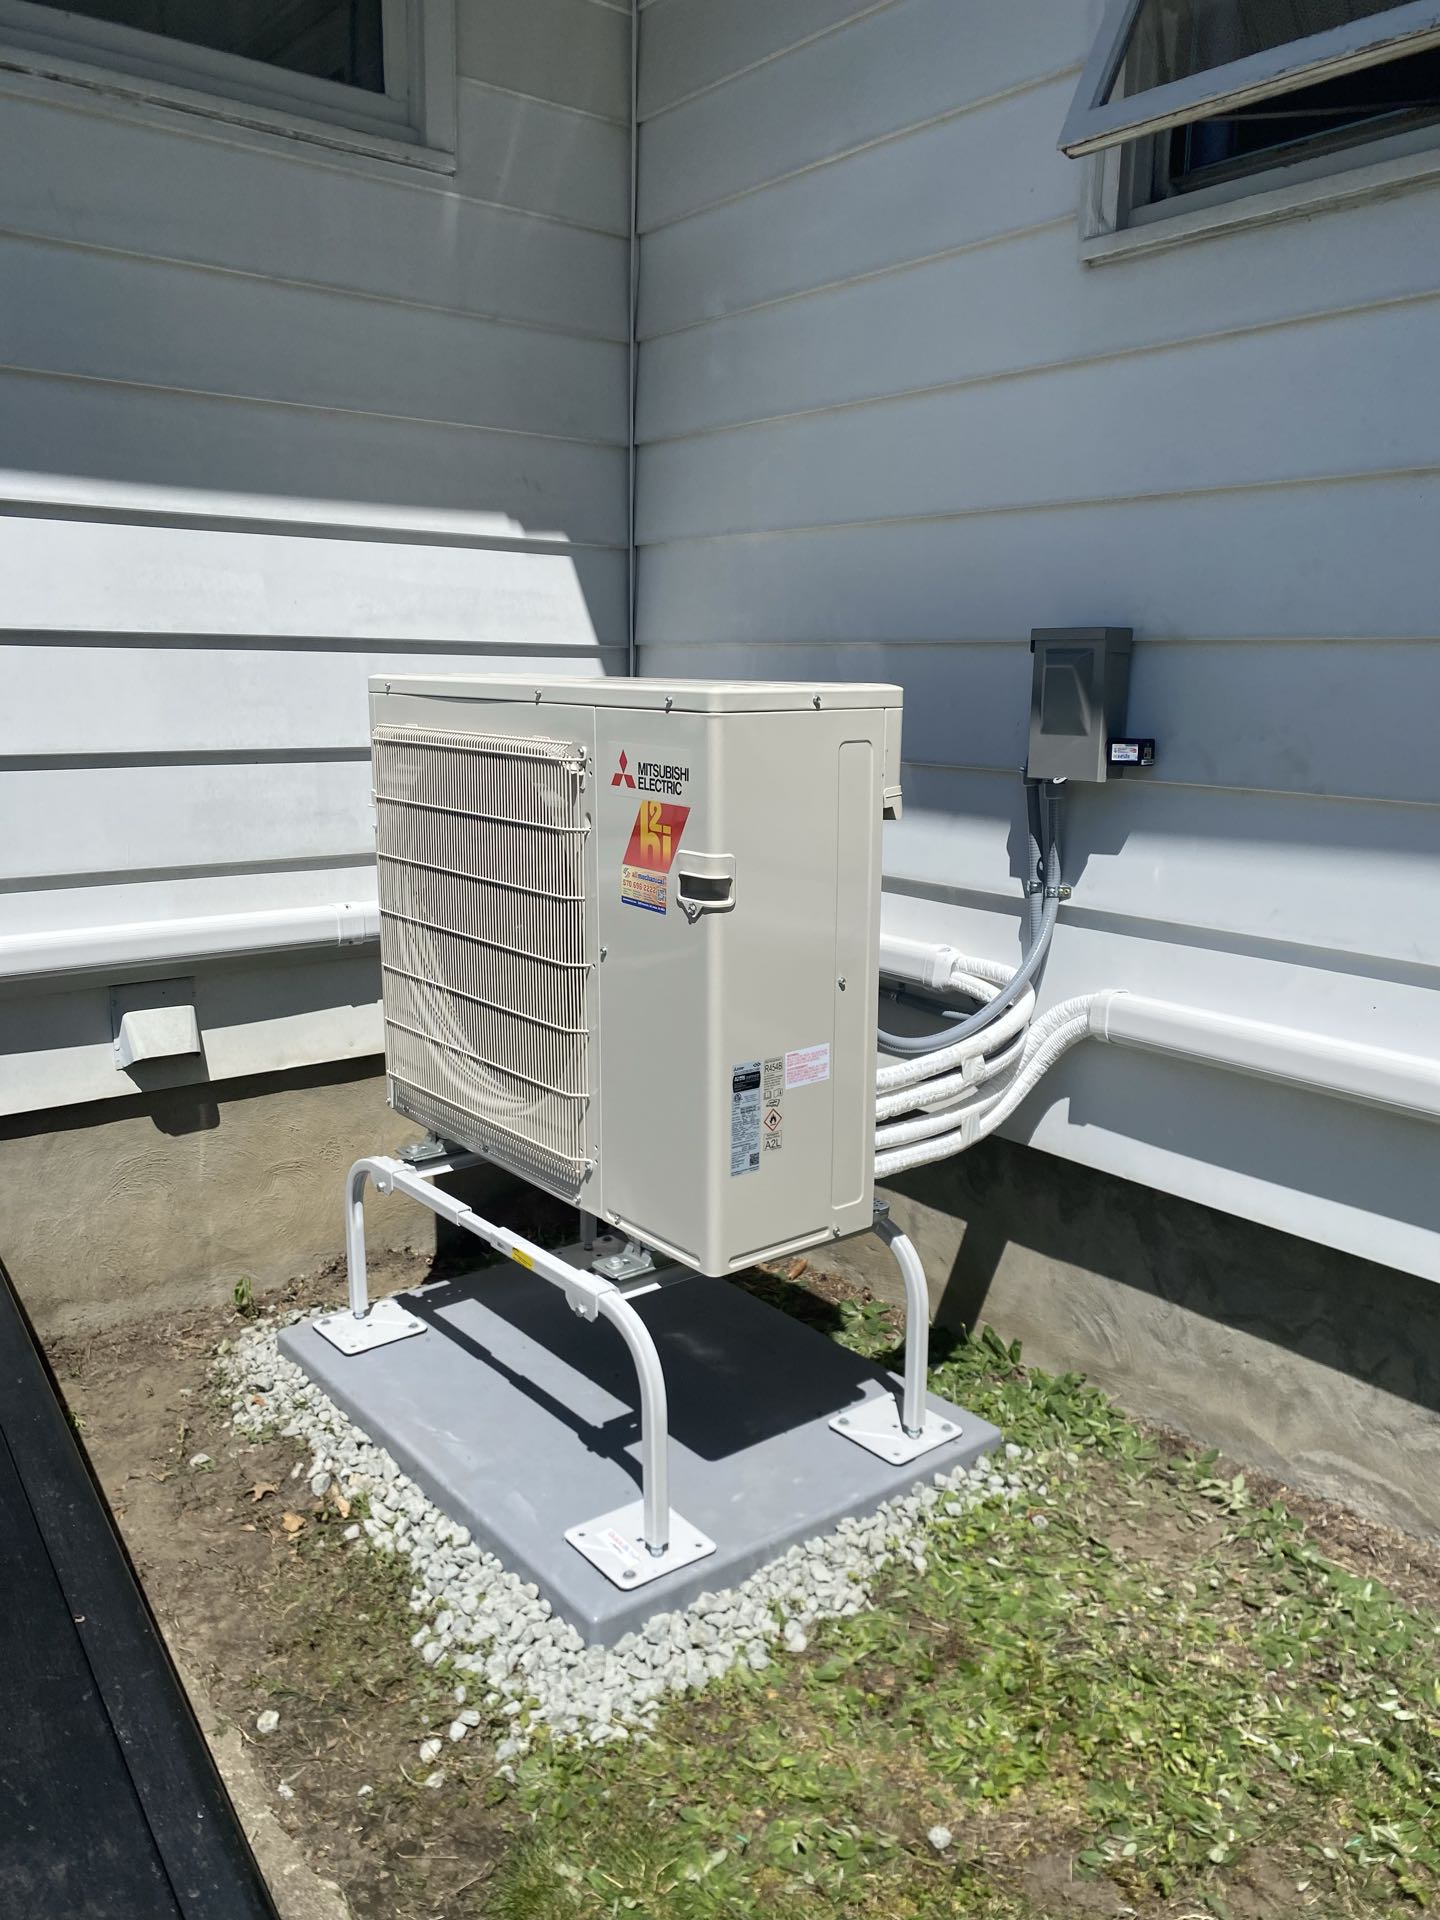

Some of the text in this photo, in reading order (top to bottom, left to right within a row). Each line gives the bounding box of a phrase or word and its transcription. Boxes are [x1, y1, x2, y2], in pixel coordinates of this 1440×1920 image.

[638, 762, 689, 782] MITSUBISHI
[638, 777, 682, 796] ELECTRIC
[643, 884, 656, 894] 2222
[764, 1061, 783, 1073] R454B
[765, 1138, 781, 1150] A2L
